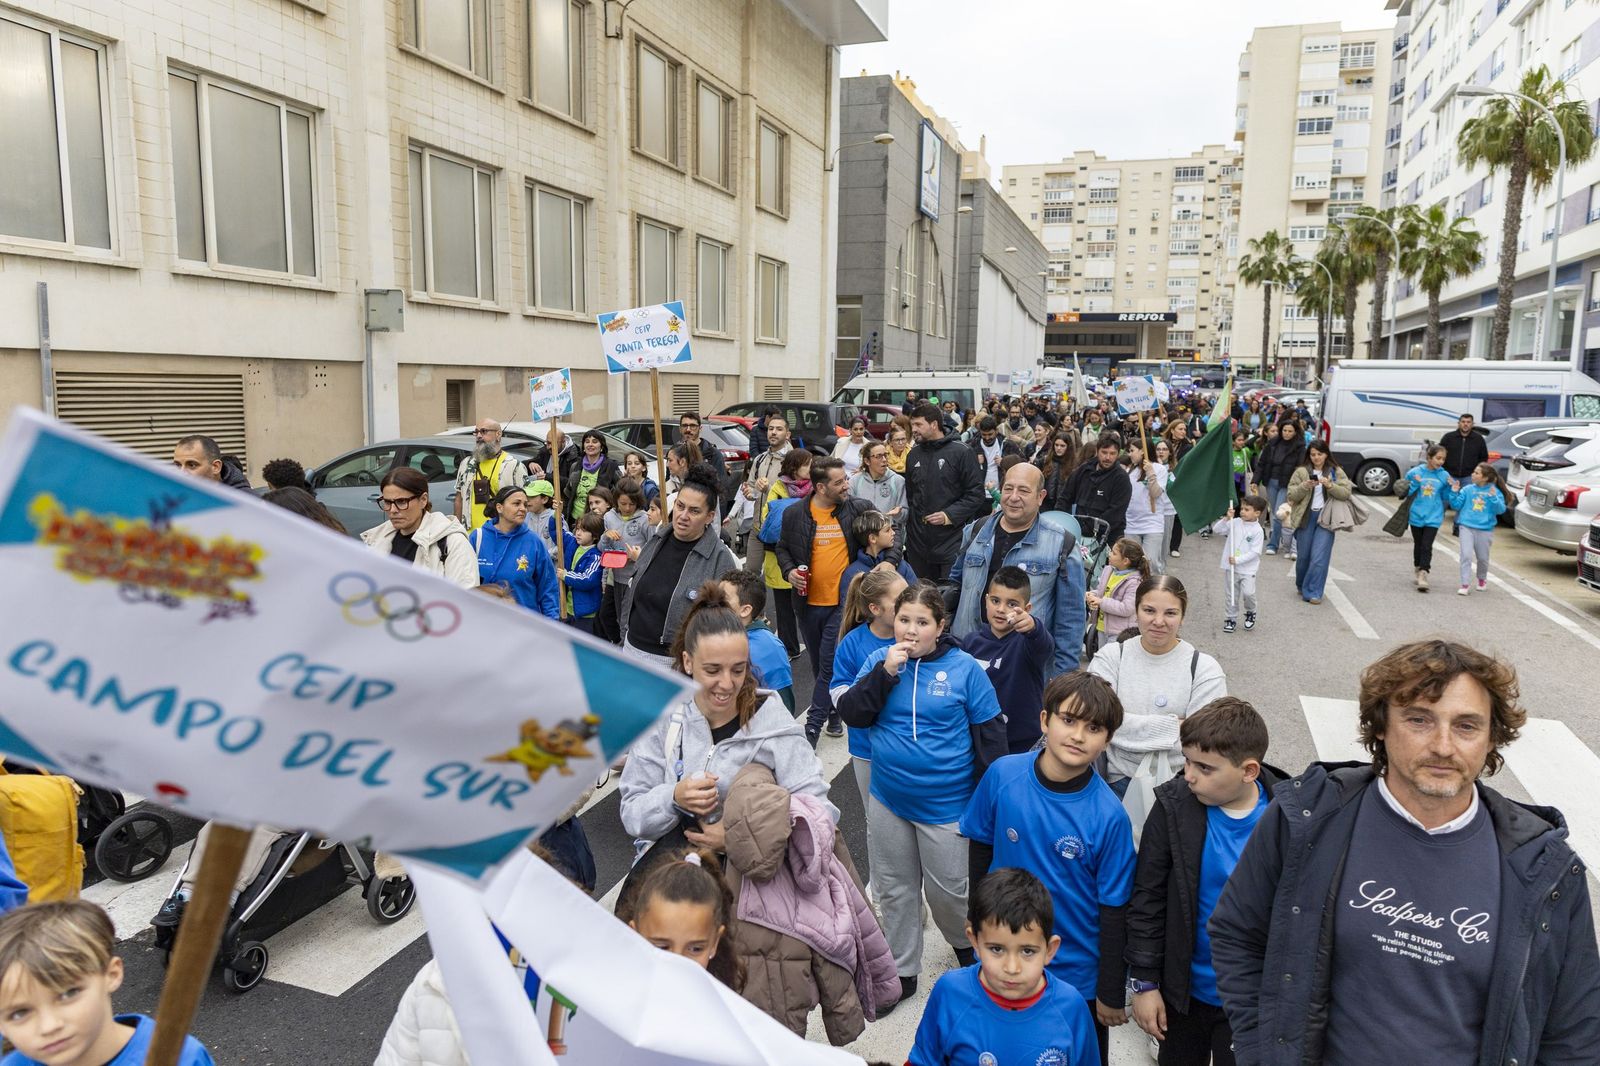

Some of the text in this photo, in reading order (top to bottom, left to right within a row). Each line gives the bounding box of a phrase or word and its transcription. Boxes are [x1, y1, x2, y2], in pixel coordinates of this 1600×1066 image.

[1118, 313, 1166, 321] REPSOL
[634, 324, 651, 335] CEIP
[615, 334, 680, 354] SANTA TERESA
[259, 652, 395, 711] CEIP
[7, 639, 531, 811] CAMPO DEL SUR
[1349, 880, 1490, 944] Scalpers Co.
[1394, 930, 1443, 949] THE STUDIO
[1382, 945, 1398, 953] that
[1399, 949, 1422, 960] people
[1387, 939, 1406, 947] relish
[1407, 943, 1433, 956] making
[1433, 951, 1456, 961] things
